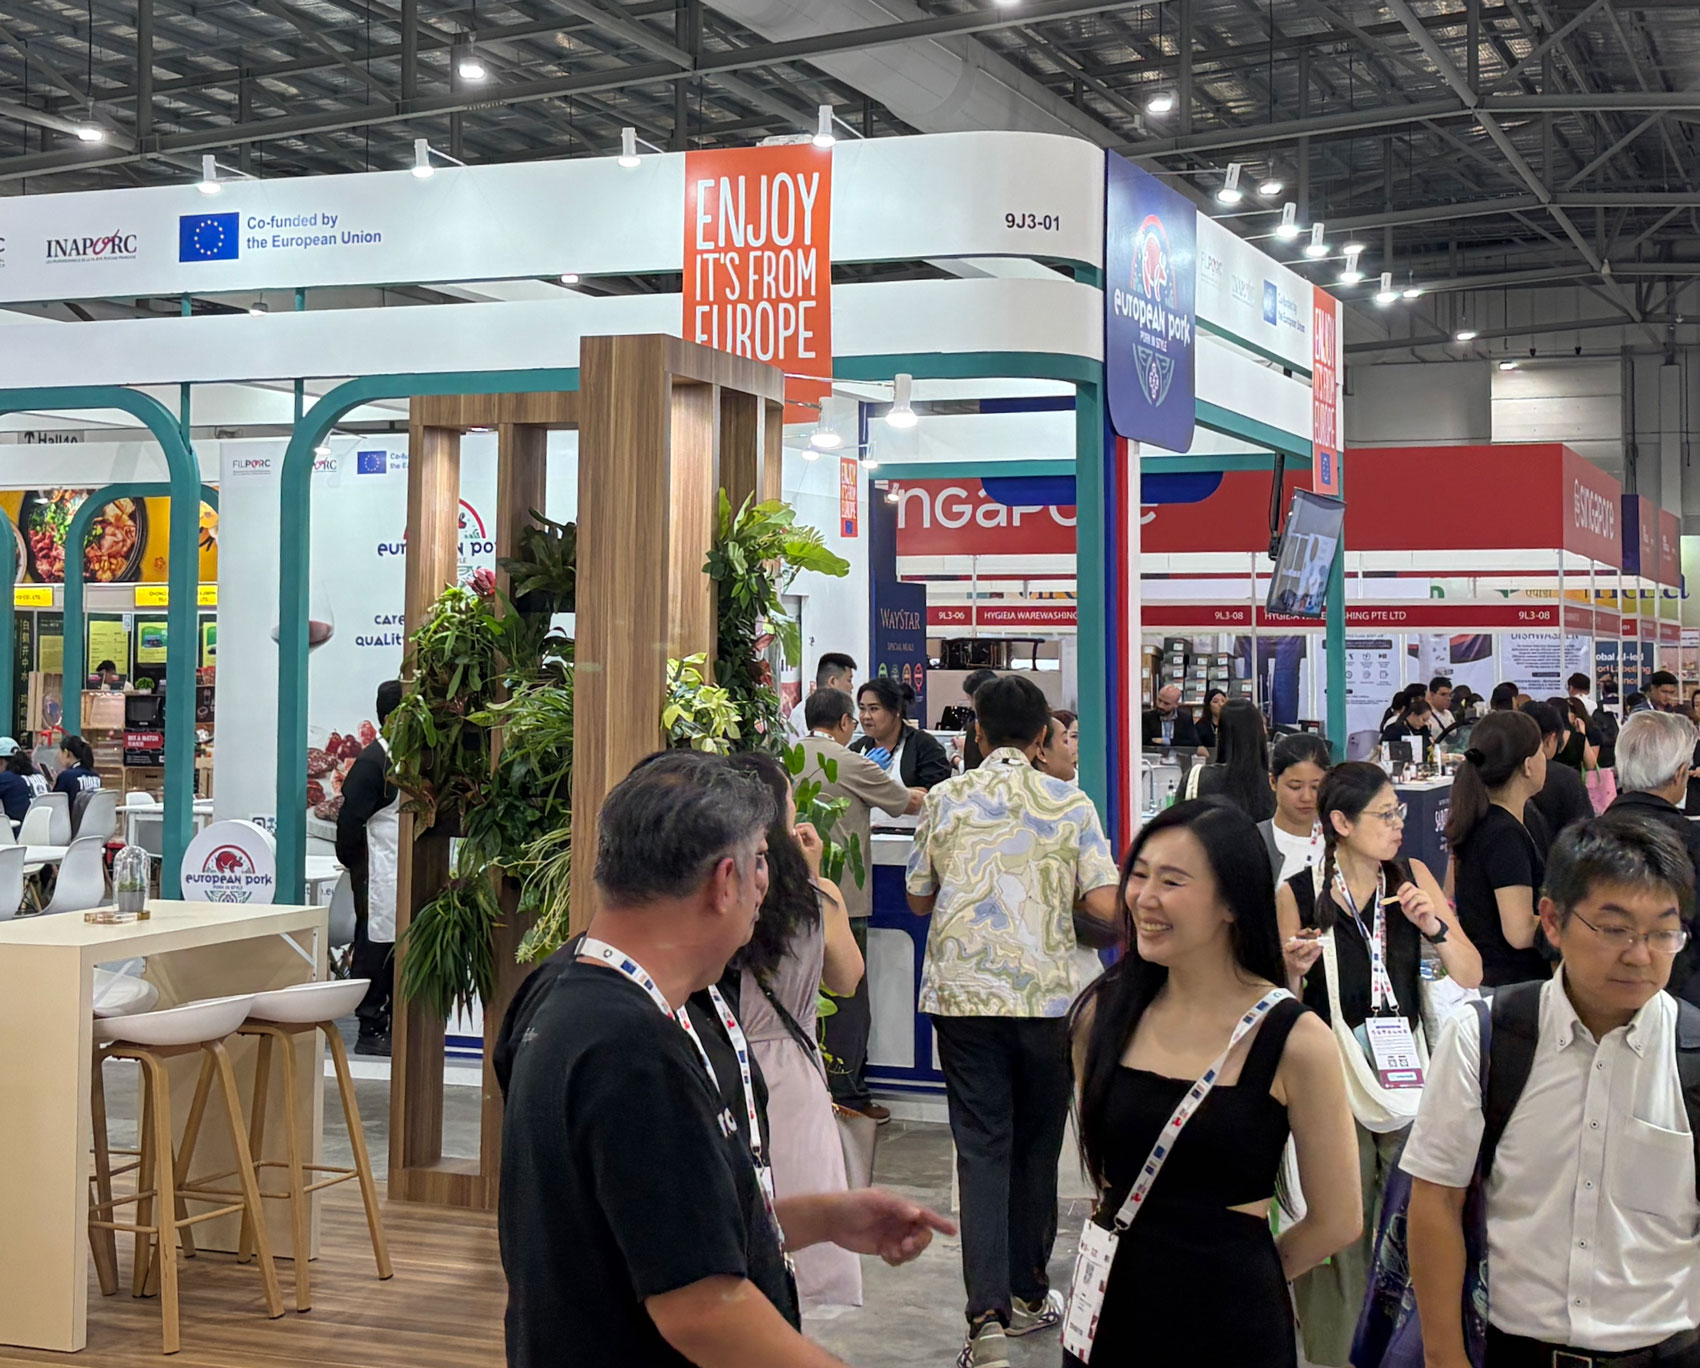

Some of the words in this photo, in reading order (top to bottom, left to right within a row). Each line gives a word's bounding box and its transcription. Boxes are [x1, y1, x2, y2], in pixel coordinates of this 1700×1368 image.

[696, 172, 820, 250] ENJOY
[247, 213, 318, 230] Co-funded
[321, 212, 339, 229] by
[1005, 213, 1060, 231] 9J3-01
[46, 229, 137, 258] INAPORC
[246, 236, 268, 249] the
[272, 234, 337, 250] European
[341, 230, 382, 245] Union
[695, 252, 741, 301] IT'S
[748, 248, 817, 300] FROM
[695, 301, 817, 362] EUROPE
[1167, 312, 1191, 348] pork
[938, 611, 965, 620] 9L3-06
[984, 611, 1016, 620] HYGIEIA
[1214, 611, 1244, 620] 9L3-08
[1371, 611, 1387, 620] PTE
[1388, 611, 1406, 620] LTD
[1518, 610, 1551, 620] 9L3-08
[245, 873, 273, 886] pork
